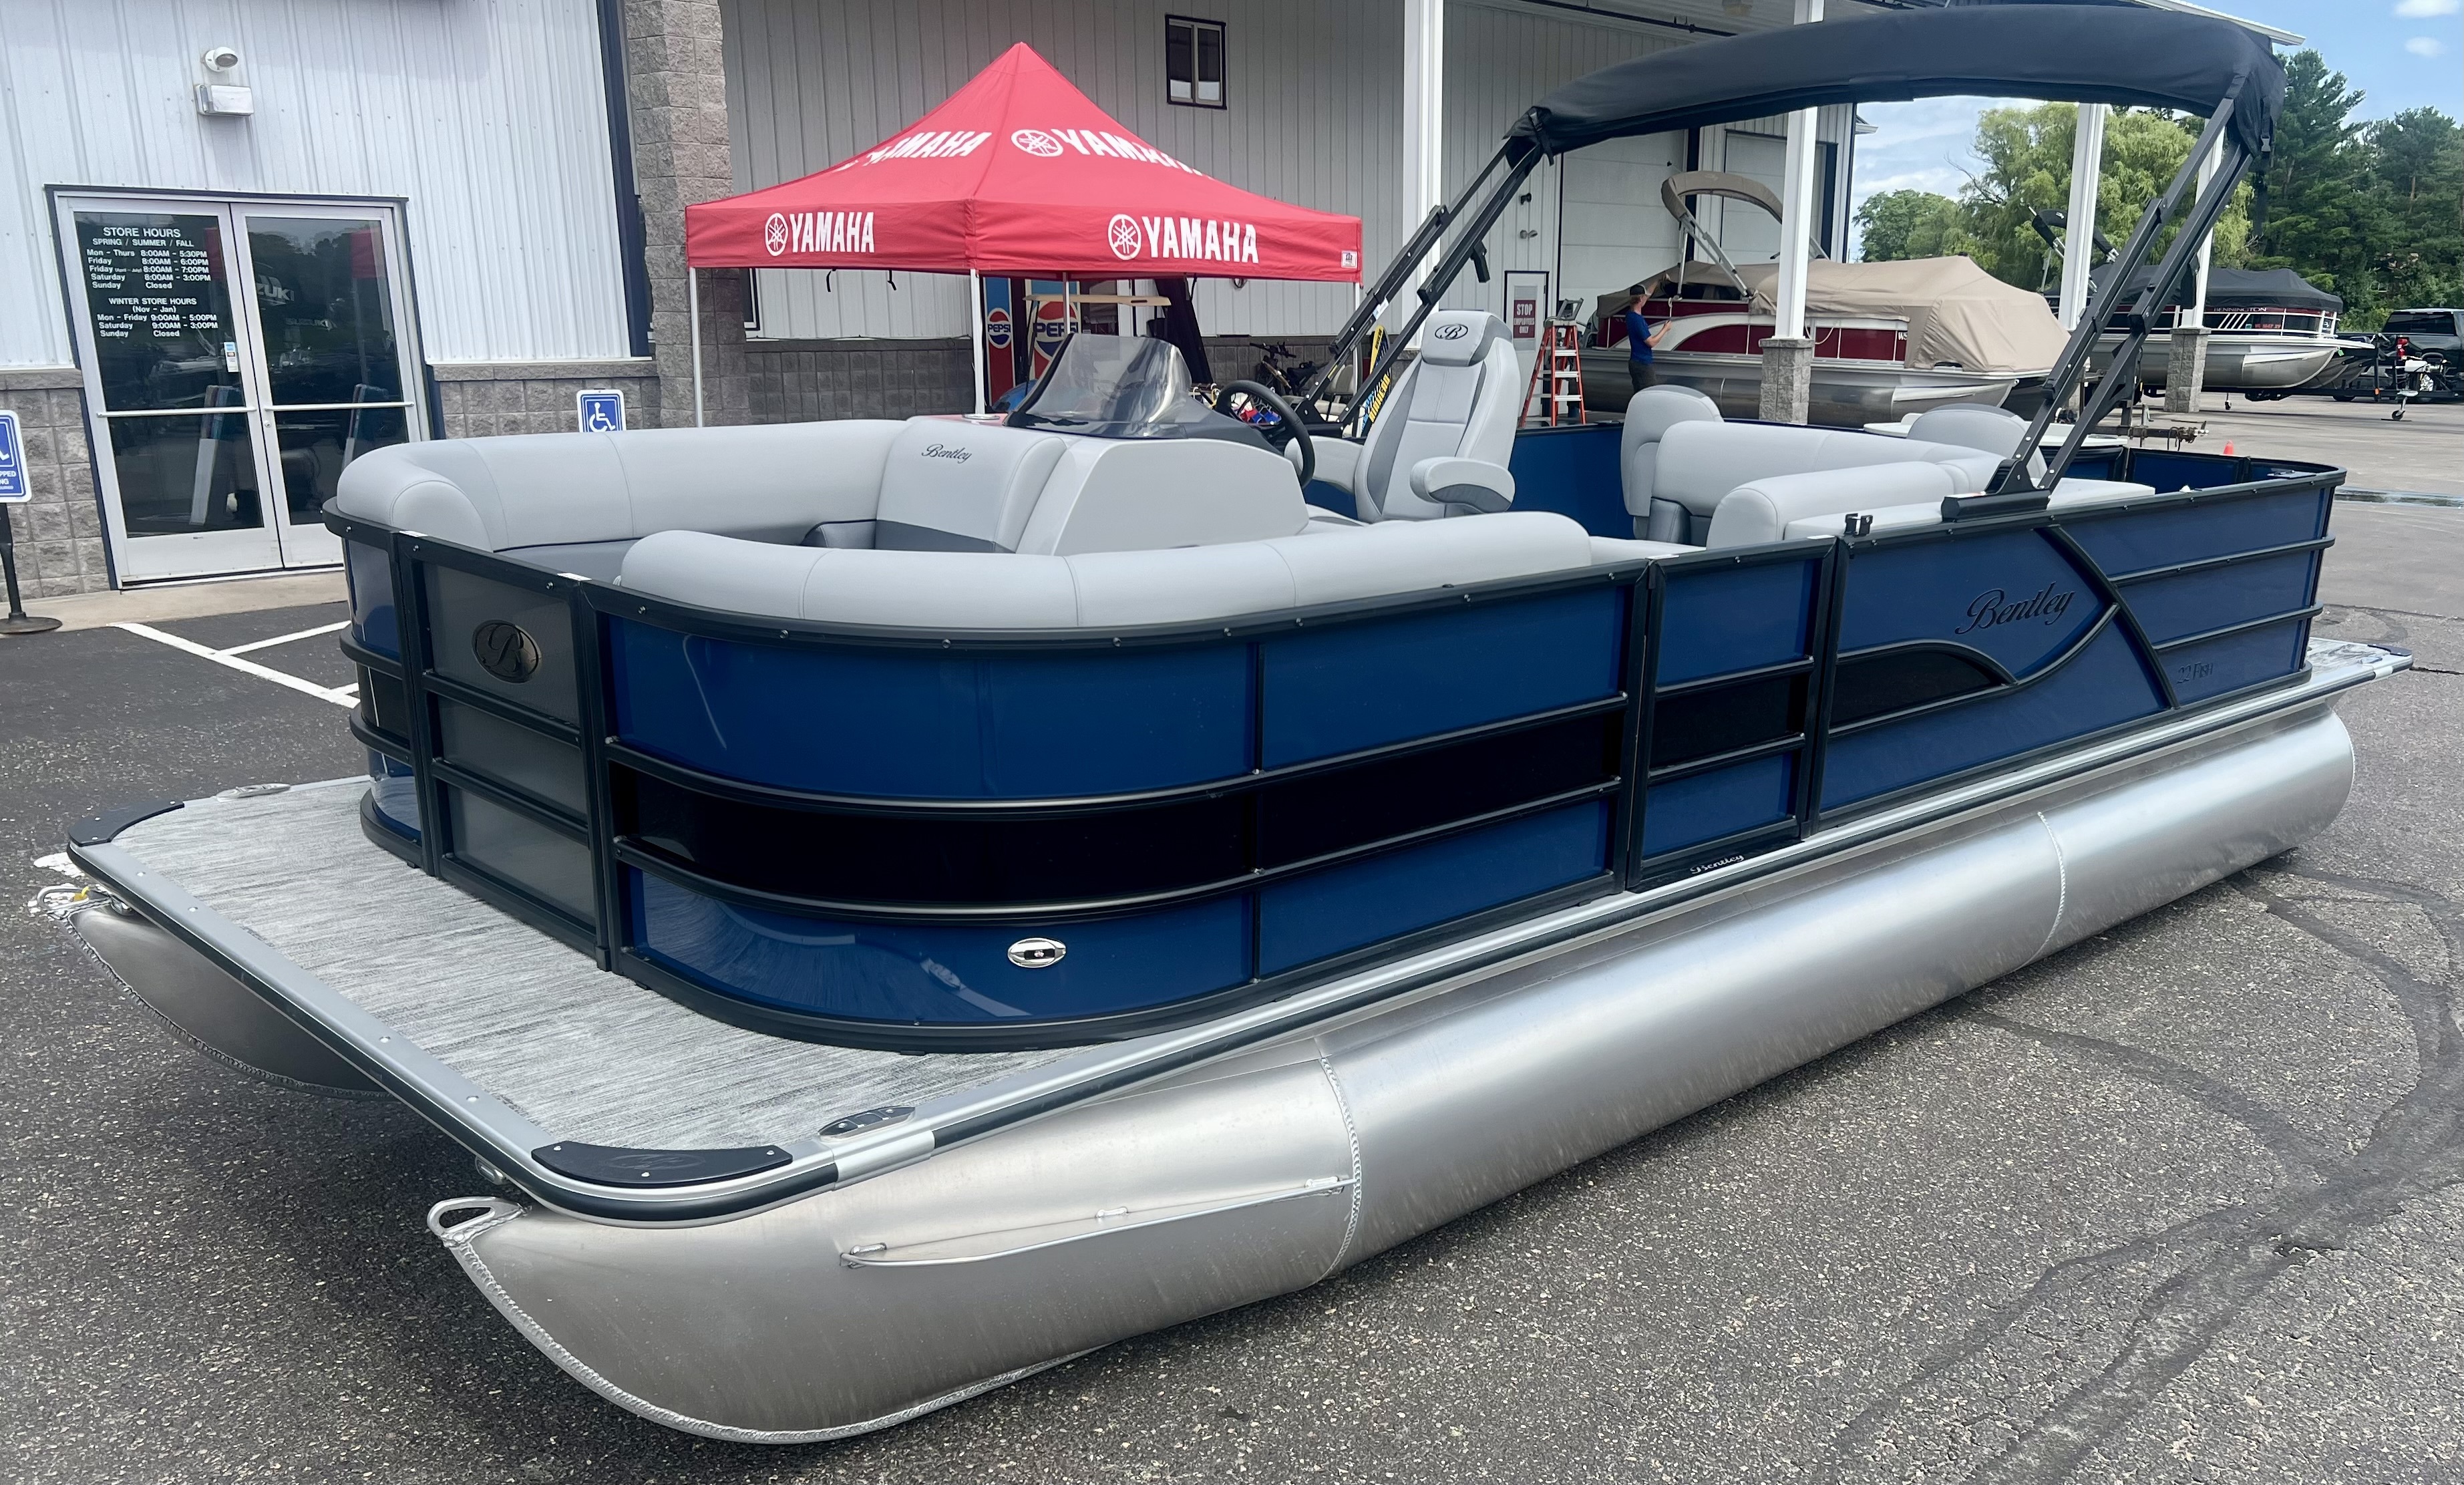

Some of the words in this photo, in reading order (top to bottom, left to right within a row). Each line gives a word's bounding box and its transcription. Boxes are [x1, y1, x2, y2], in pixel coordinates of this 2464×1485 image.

[862, 131, 992, 166] YAMAHA
[103, 226, 140, 236] STORE
[144, 228, 181, 238] HOURS
[789, 212, 875, 253] YAMAHA
[92, 238, 122, 246] SPRING
[132, 238, 166, 246] SUMMER
[176, 239, 194, 247] FALL
[1141, 215, 1259, 264] YAMAHA
[87, 257, 112, 265] Friday
[89, 265, 113, 273] Friday
[90, 273, 126, 281] Saturday
[92, 282, 121, 290] Sunday
[256, 283, 295, 301] ZUKI
[1517, 303, 1533, 316] STOP
[124, 314, 148, 322] Friday
[1514, 317, 1535, 325] EMPLOYEES
[98, 322, 133, 330] Saturday
[987, 323, 1011, 333] PEPSI
[100, 330, 129, 338] Sunday
[921, 444, 973, 464] Bentley
[1955, 581, 2076, 635] Bentley
[2176, 665, 2191, 684] 22
[1690, 855, 1745, 874] Bentley
